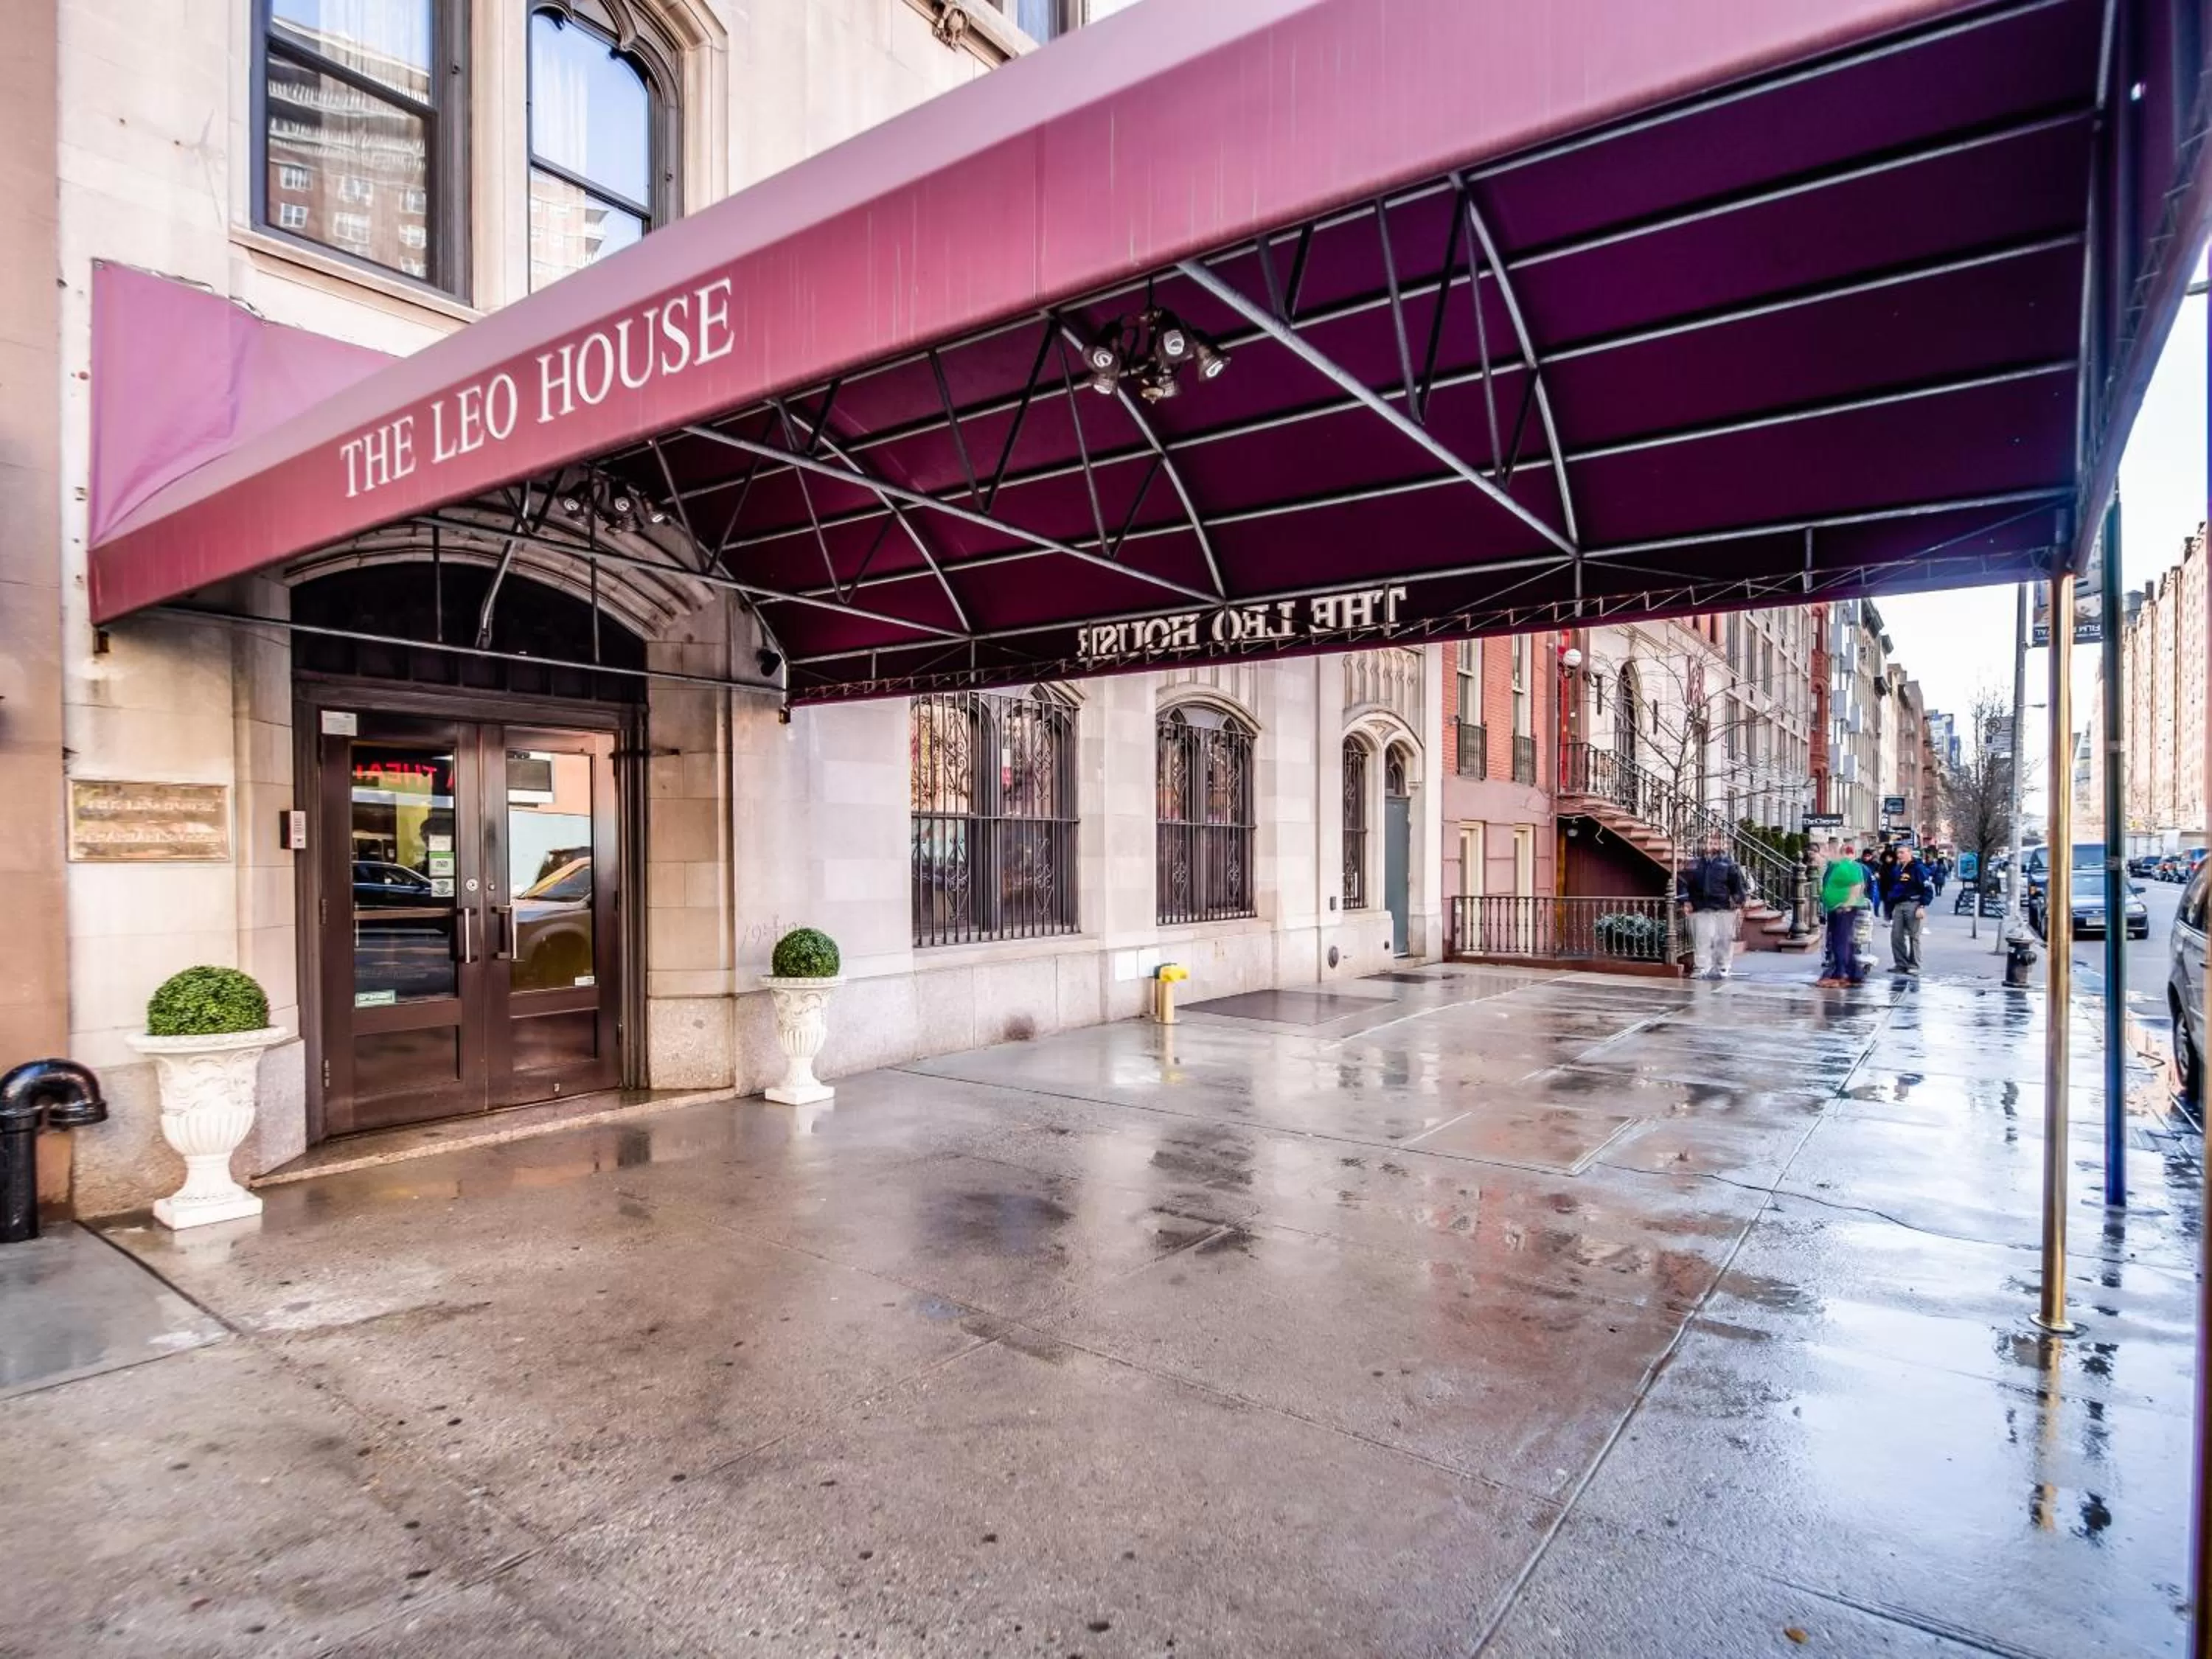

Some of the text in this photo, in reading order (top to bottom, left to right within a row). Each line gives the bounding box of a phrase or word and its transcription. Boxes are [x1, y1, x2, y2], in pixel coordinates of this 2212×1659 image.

[339, 276, 735, 498] THE LEO HOUSE
